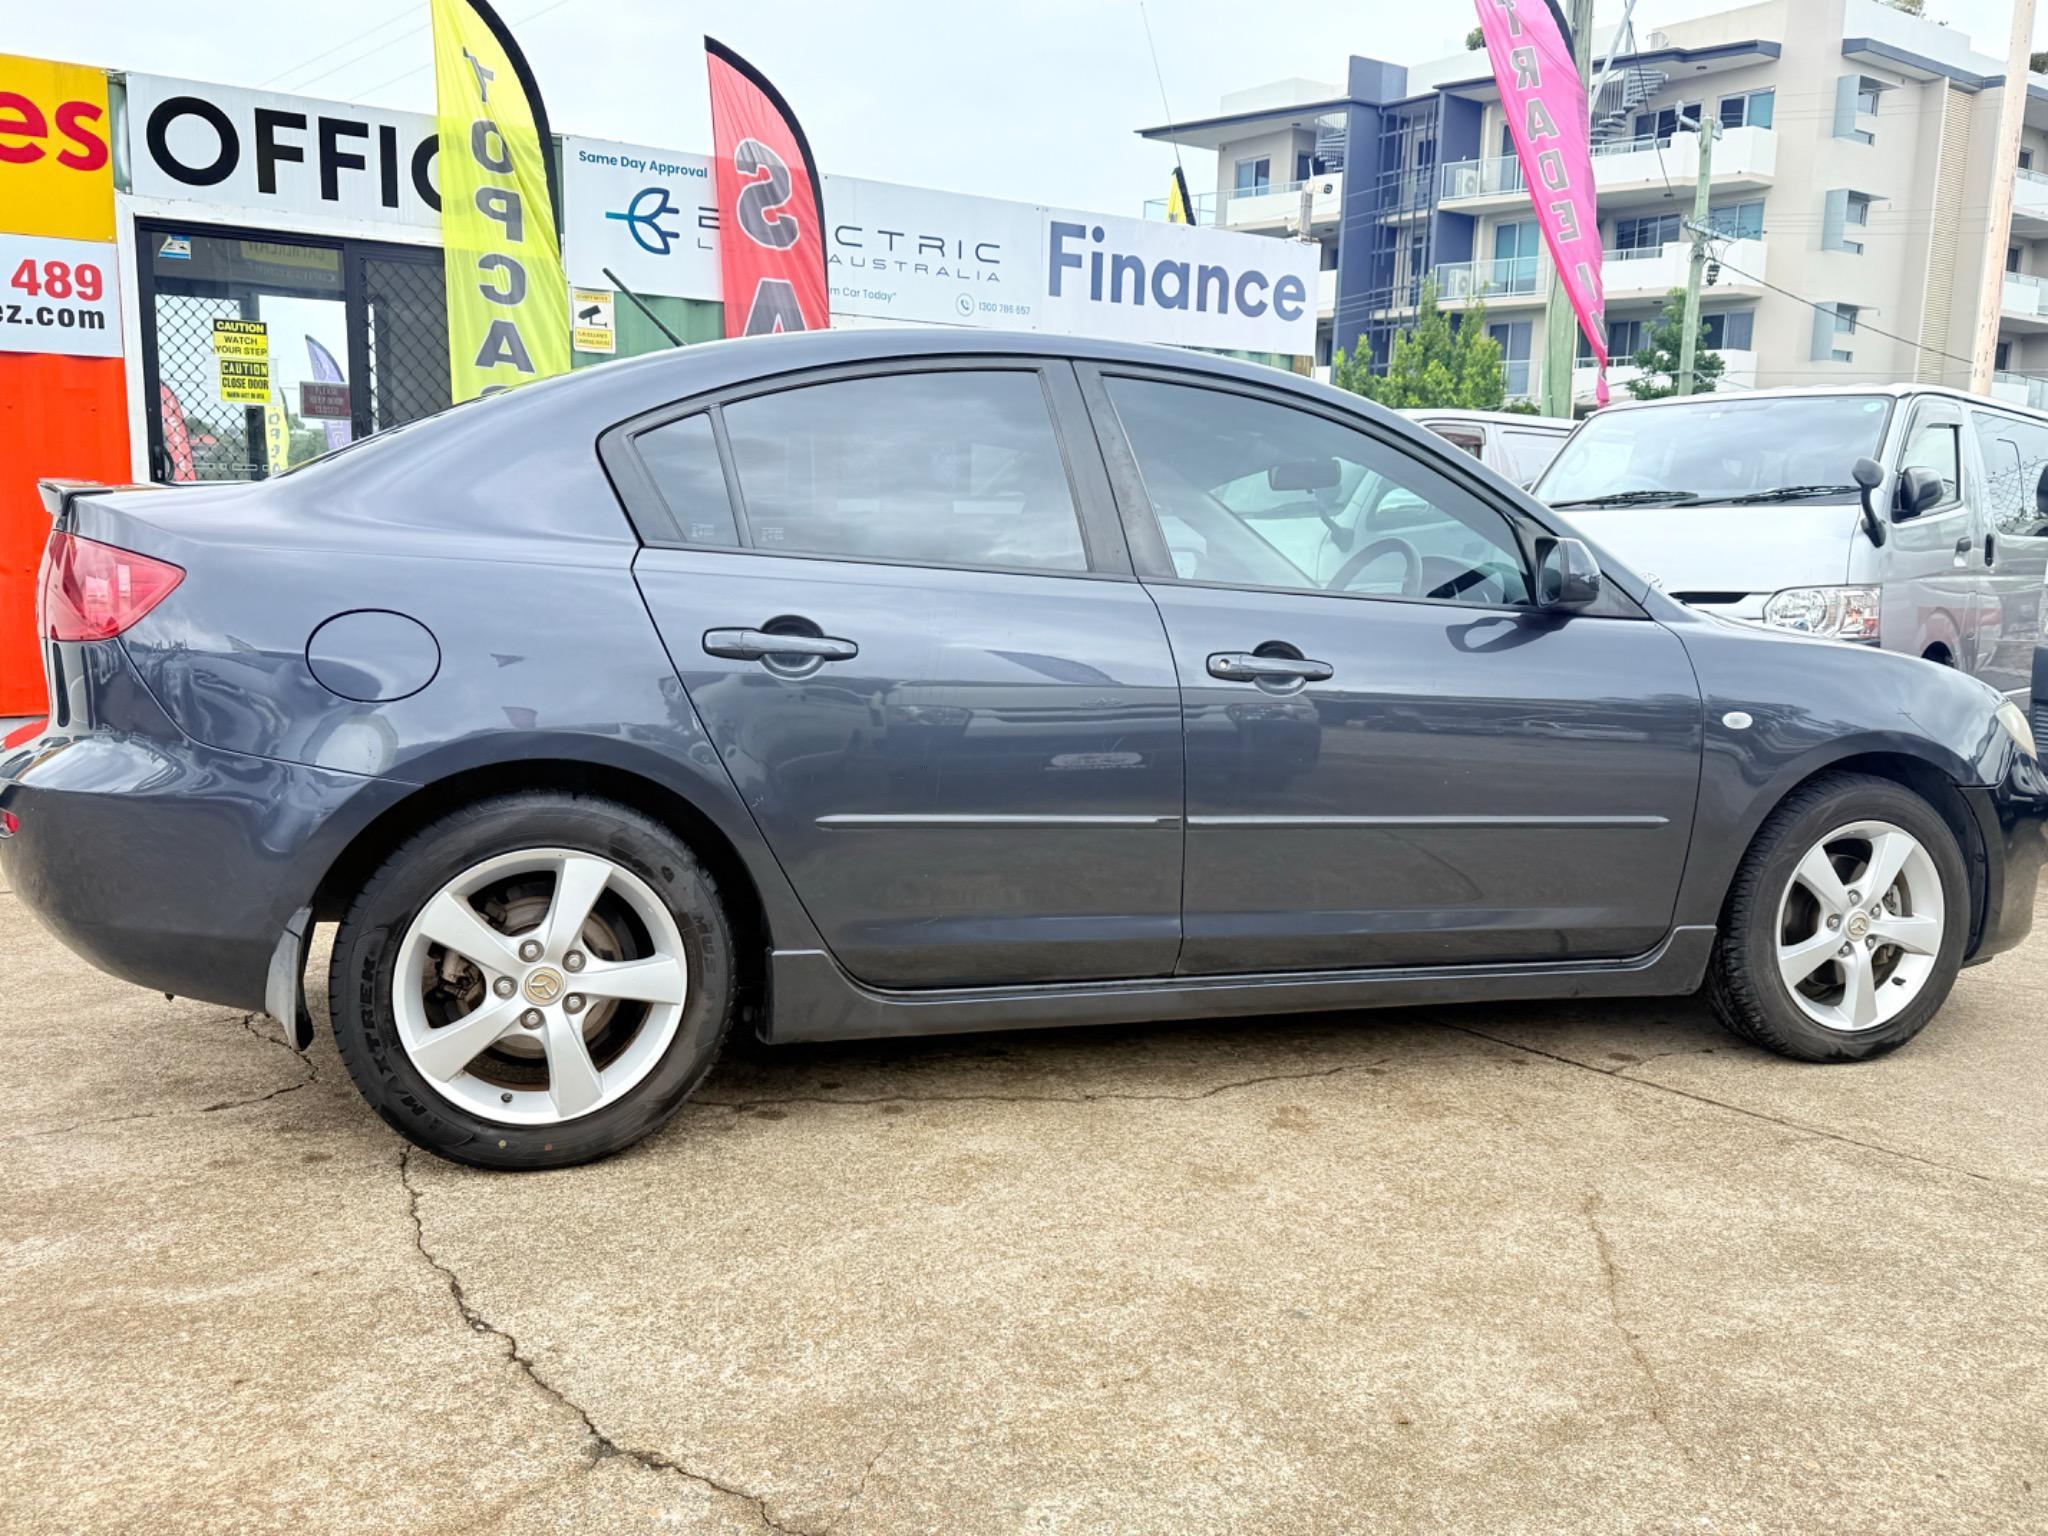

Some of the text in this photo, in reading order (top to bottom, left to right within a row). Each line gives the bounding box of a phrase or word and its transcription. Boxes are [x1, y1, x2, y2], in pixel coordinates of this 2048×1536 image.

[579, 150, 708, 179] Same Day Approval
[827, 253, 1001, 283] AUSTRALIA
[1048, 220, 1306, 322] Finance
[11, 258, 103, 302] 489
[0, 302, 105, 330] z.com
[215, 321, 264, 334] CAUTION
[214, 345, 268, 356] YOUR STEP
[223, 335, 258, 345] WATCH
[222, 362, 268, 376] CAUTION
[222, 377, 269, 389] CLOSE DOOR
